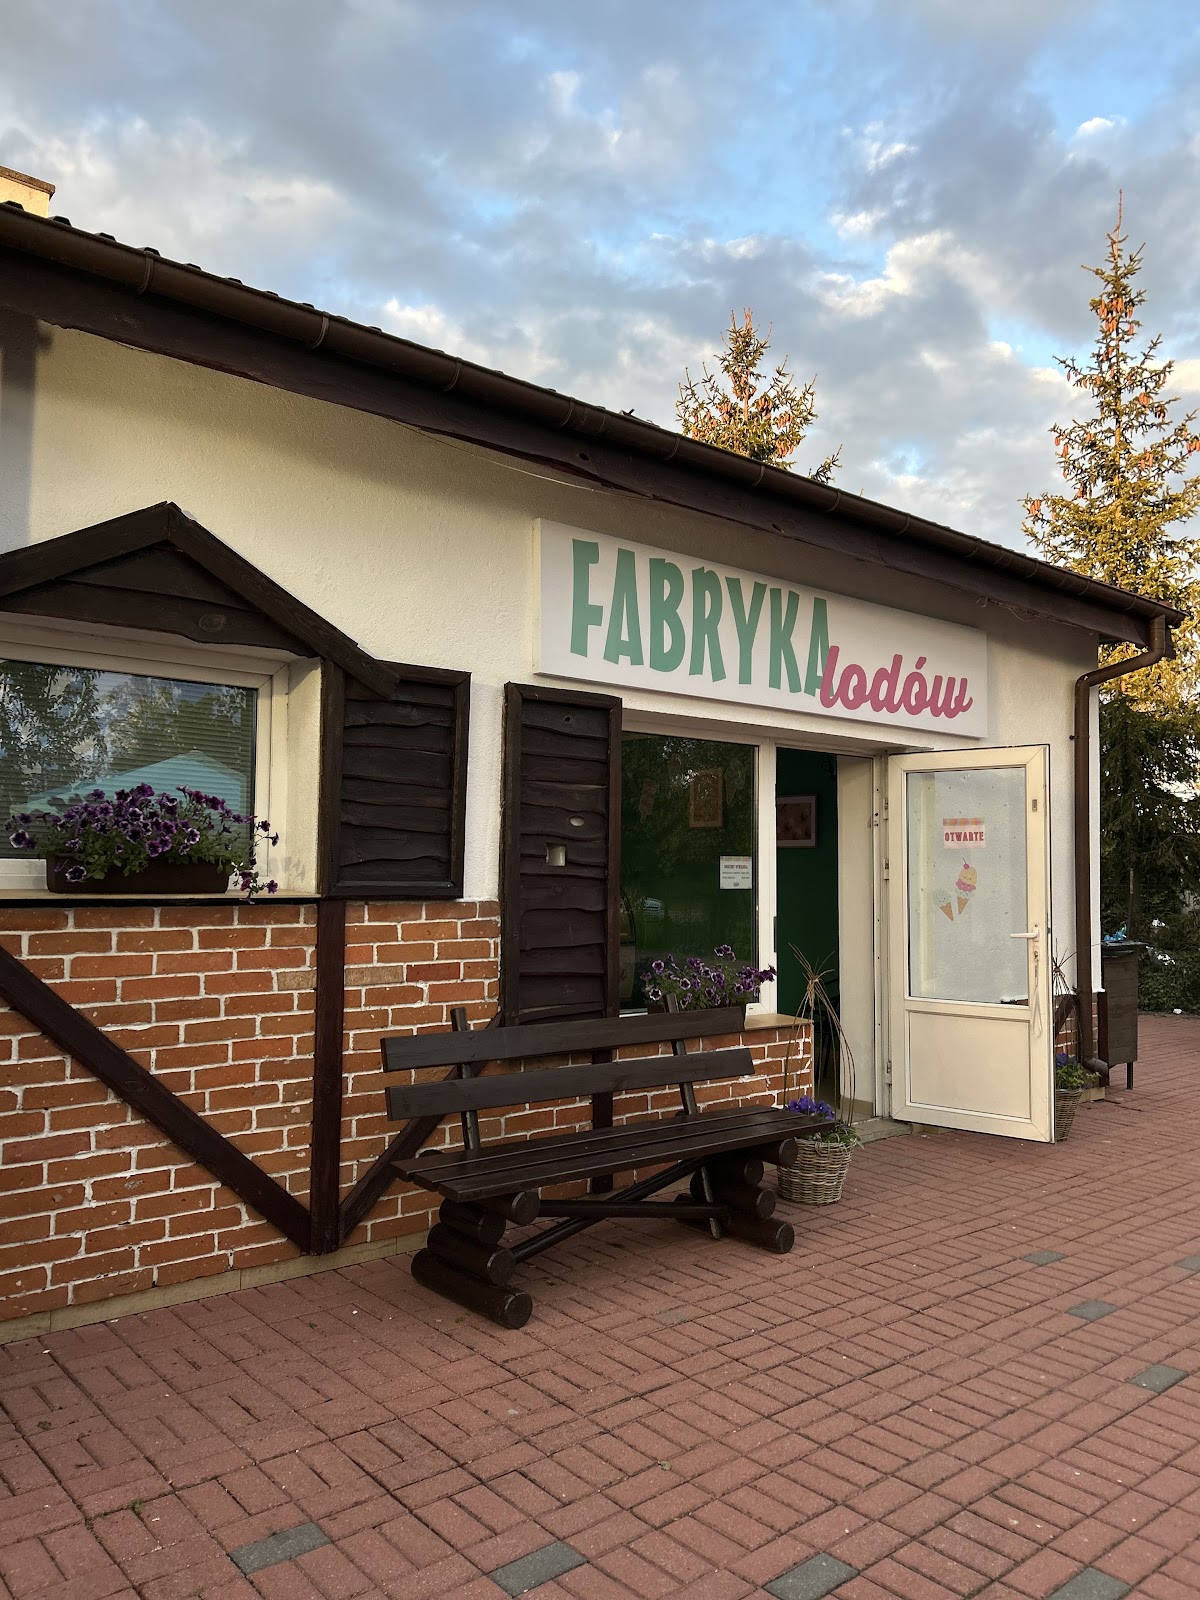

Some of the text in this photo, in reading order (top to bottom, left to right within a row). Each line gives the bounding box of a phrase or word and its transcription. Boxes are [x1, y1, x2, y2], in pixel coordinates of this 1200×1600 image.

[570, 539, 835, 697] FABRYKA
[820, 645, 973, 718] lodów
[944, 831, 985, 842] OTWARTE
